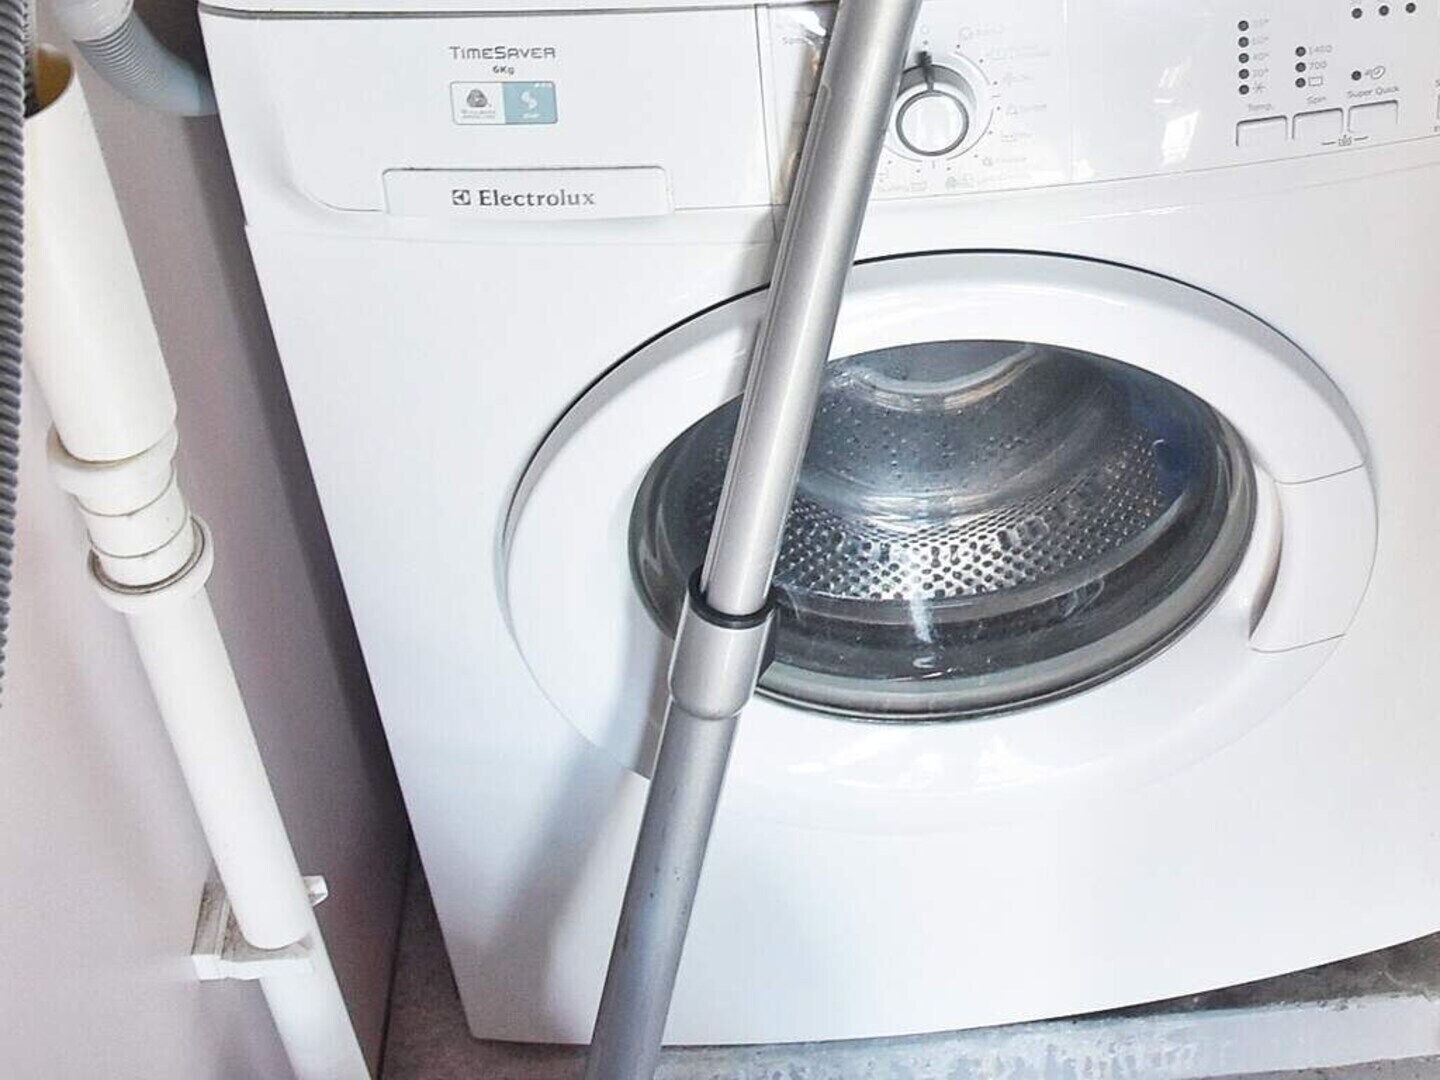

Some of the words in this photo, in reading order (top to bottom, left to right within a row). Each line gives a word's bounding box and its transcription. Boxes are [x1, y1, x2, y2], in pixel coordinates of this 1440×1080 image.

[1347, 90, 1372, 99] Super
[1375, 86, 1400, 95] Quick
[478, 188, 596, 207] Electrolux
